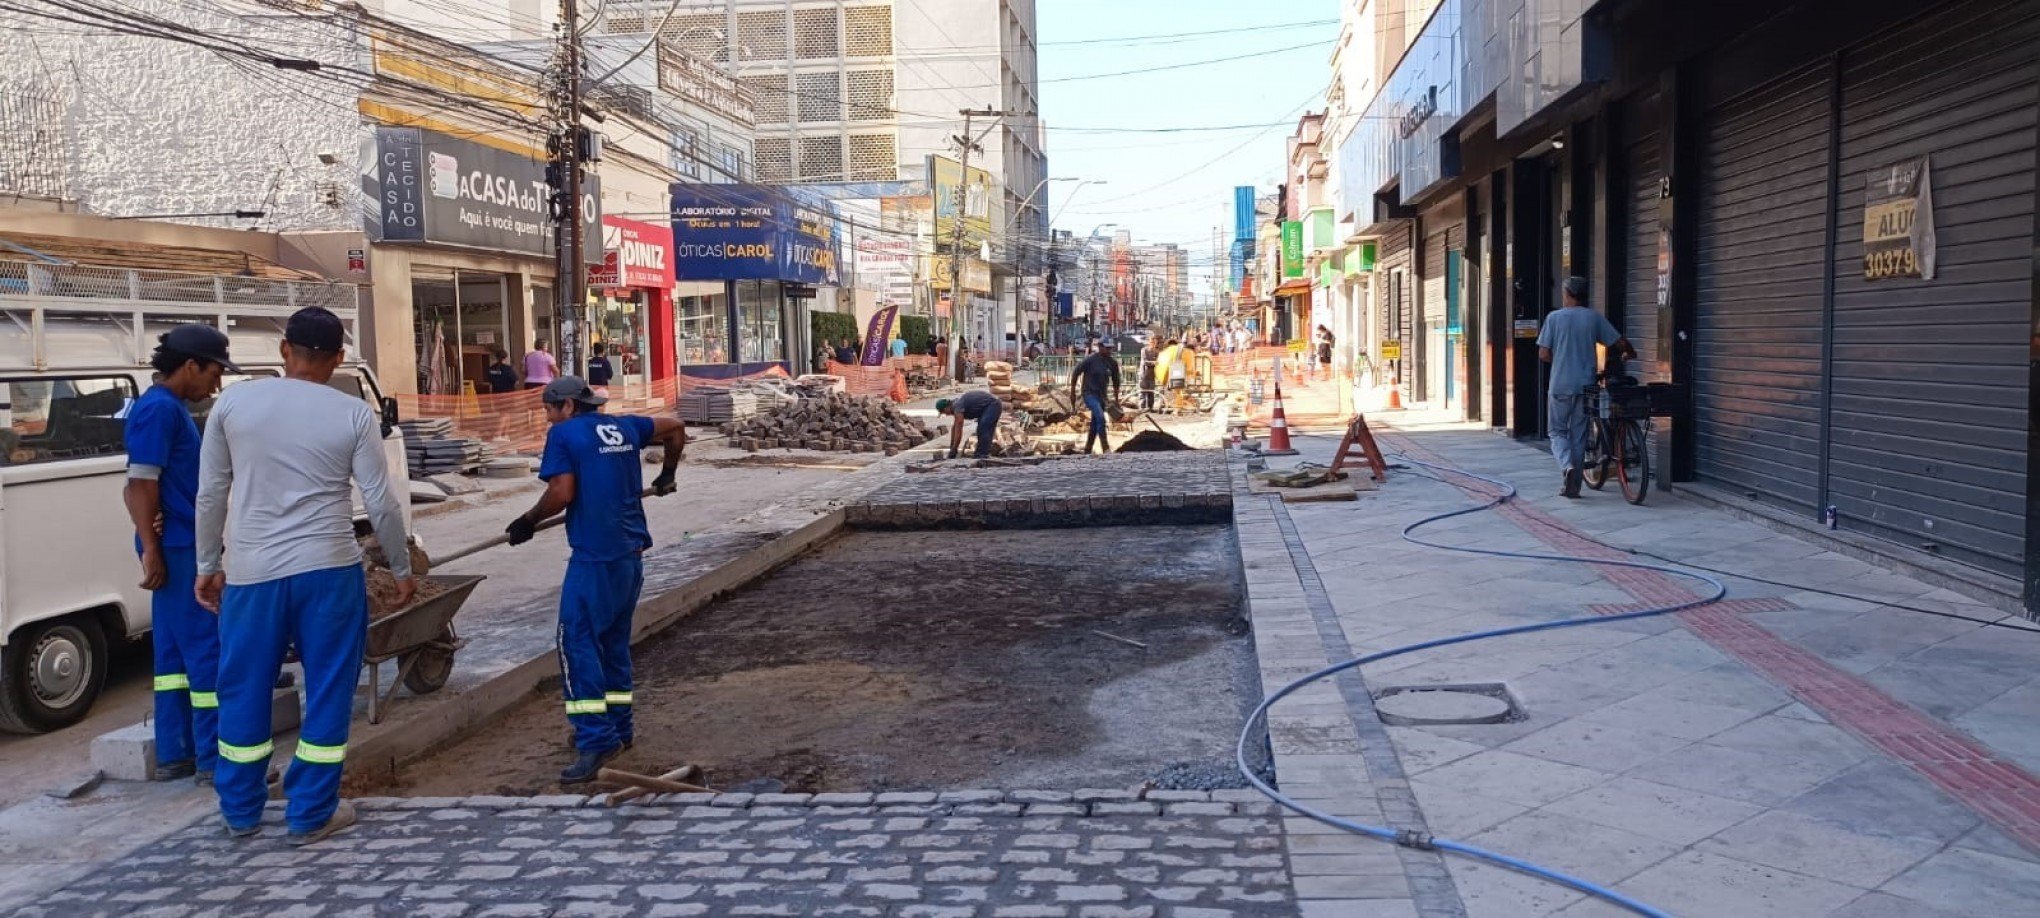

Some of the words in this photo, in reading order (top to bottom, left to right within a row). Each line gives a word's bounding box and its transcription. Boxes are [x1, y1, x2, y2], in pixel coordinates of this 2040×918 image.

[384, 152, 400, 224] CASA
[402, 147, 417, 227] TECIDO
[459, 207, 483, 229] Aqui
[485, 211, 490, 227] é
[492, 214, 513, 230] você
[514, 219, 539, 237] quem
[623, 240, 665, 270] DINIZ
[588, 275, 618, 285] DINIZ
